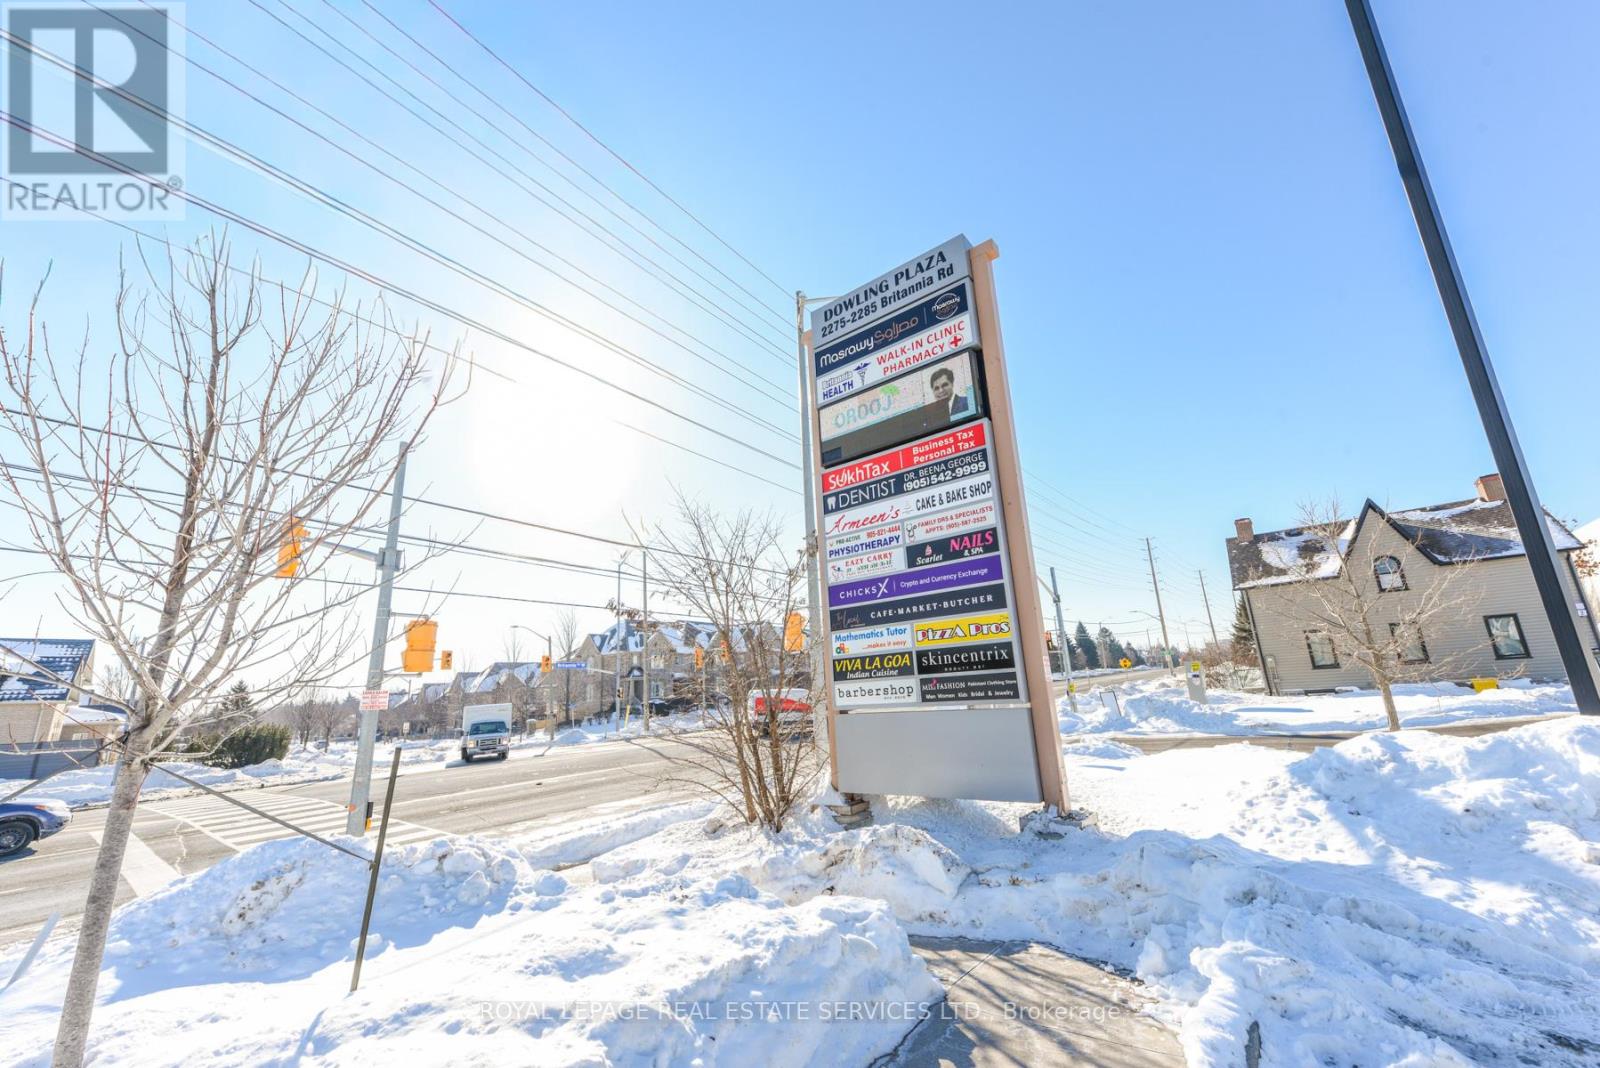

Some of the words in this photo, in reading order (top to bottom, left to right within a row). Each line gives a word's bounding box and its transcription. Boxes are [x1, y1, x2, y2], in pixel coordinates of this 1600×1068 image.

[824, 280, 889, 322] DOWLING
[894, 251, 946, 286] PLAZA
[822, 305, 877, 338] 2275-2285
[881, 277, 934, 308] Britannia
[938, 263, 954, 281] Rd
[876, 339, 923, 366] WALK-IN
[927, 320, 965, 344] CLINIC
[883, 343, 945, 376] PHARMACY
[822, 380, 854, 400] HEALTH
[912, 435, 953, 454] Business
[956, 429, 974, 440] Tax
[913, 447, 955, 464] Personal
[957, 440, 975, 452] Tax
[904, 472, 918, 482] DR.
[919, 464, 946, 478] BEENA
[948, 452, 983, 468] GEORGE
[838, 478, 896, 507] DENTIST
[915, 496, 936, 511] CAKE
[939, 495, 943, 506] &
[946, 490, 968, 504] BAKE
[970, 481, 992, 498] SHOP
[826, 506, 900, 534] Armeen's
[917, 517, 936, 527] FAMILY
[955, 506, 993, 519] SPECIALISTS
[828, 534, 901, 558] PHYSIOTHERAPY
[950, 531, 993, 552] NAILS
[915, 554, 943, 565] Scarlet
[900, 578, 918, 588] Crypto
[931, 573, 957, 583] Currency
[958, 567, 988, 579] Exchange
[835, 630, 884, 642] Mathematics
[886, 627, 907, 636] Tutor
[835, 658, 862, 671] VIVA
[866, 656, 881, 669] LA
[883, 654, 911, 667] GOA
[922, 646, 1008, 666] skincentrix
[847, 671, 870, 679] Indian
[936, 682, 965, 690] FASHION
[838, 684, 914, 699] barbershop
